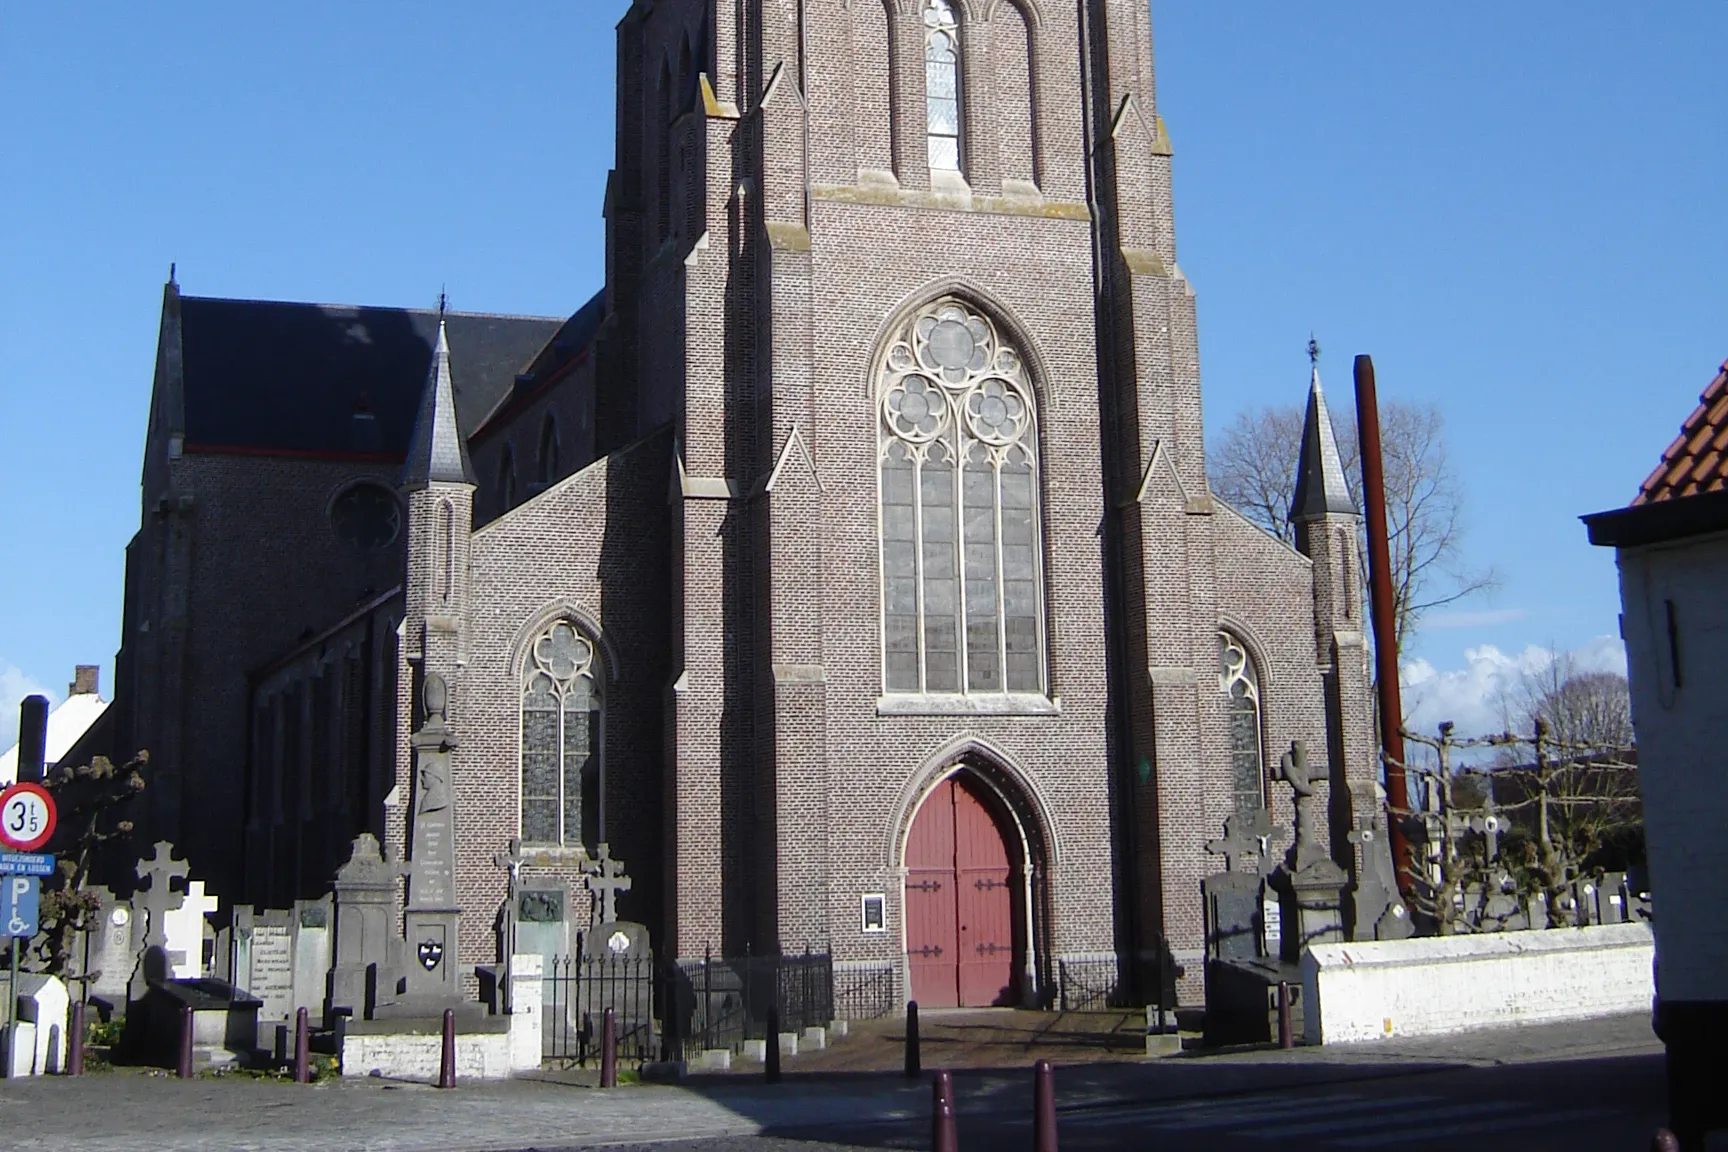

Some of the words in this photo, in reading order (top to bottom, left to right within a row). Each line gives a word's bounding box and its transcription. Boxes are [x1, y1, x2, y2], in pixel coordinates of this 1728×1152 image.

[10, 801, 26, 832] 3
[29, 817, 38, 832] 5
[12, 877, 30, 905] P
